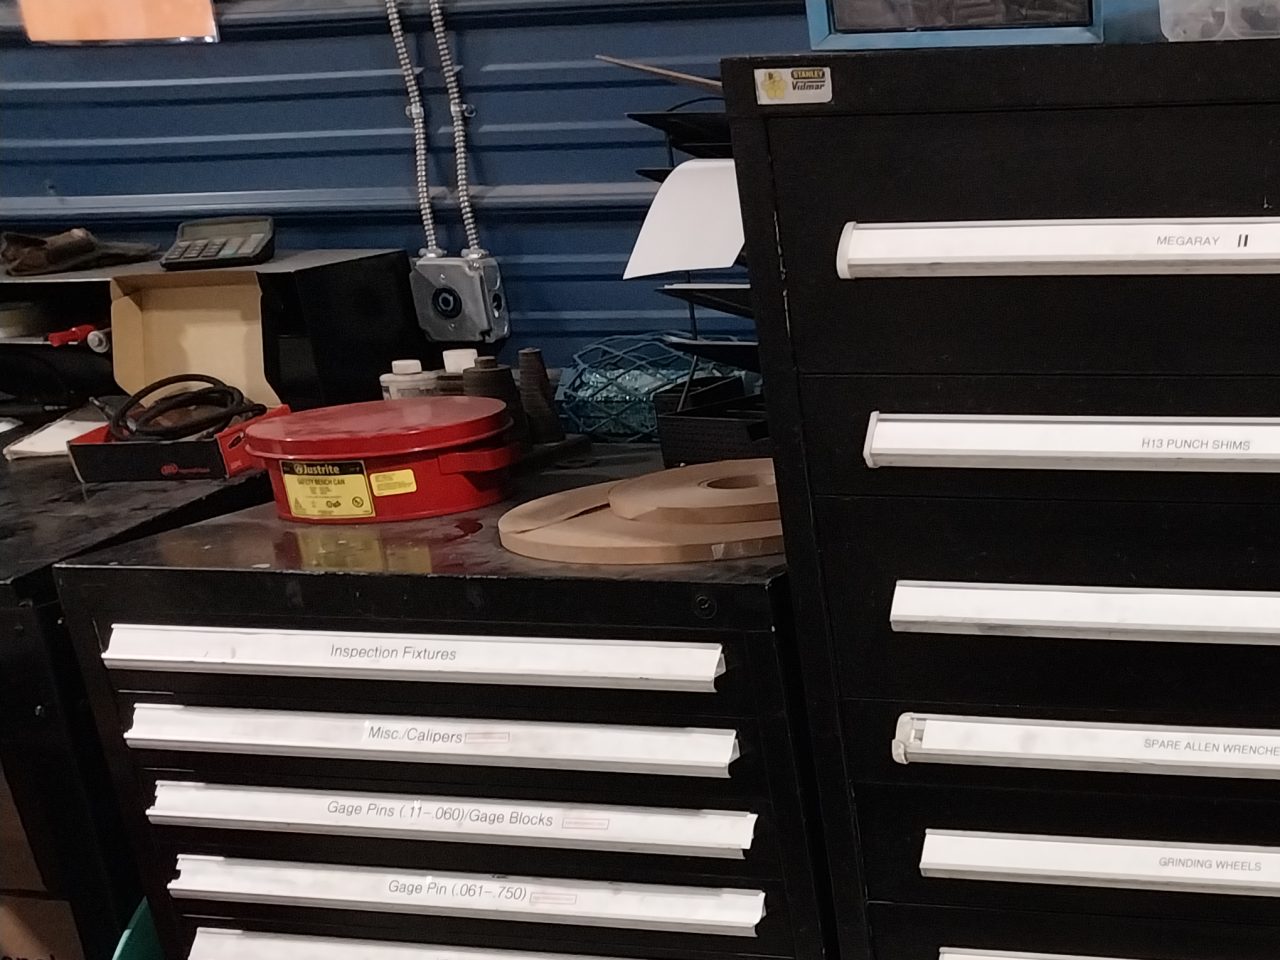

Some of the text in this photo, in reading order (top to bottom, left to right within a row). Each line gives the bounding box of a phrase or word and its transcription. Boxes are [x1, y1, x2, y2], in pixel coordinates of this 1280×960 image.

[792, 70, 824, 79] STANLEY
[1157, 235, 1220, 246] MEGARAY
[1142, 438, 1251, 451] H13 PUNCH SHIMS
[304, 464, 340, 474] Justrite
[330, 644, 457, 660] Inspection Fixtures
[368, 726, 462, 744] Misc./Calipers
[1143, 738, 1182, 750] SPARE
[1184, 741, 1220, 753] ALLEN
[327, 800, 362, 816] Gage
[366, 803, 394, 816] Pins
[509, 812, 553, 827] Blocks
[1158, 857, 1262, 871] GRINDING WHEELS
[388, 880, 422, 895] Gage
[426, 881, 447, 895] Pin
